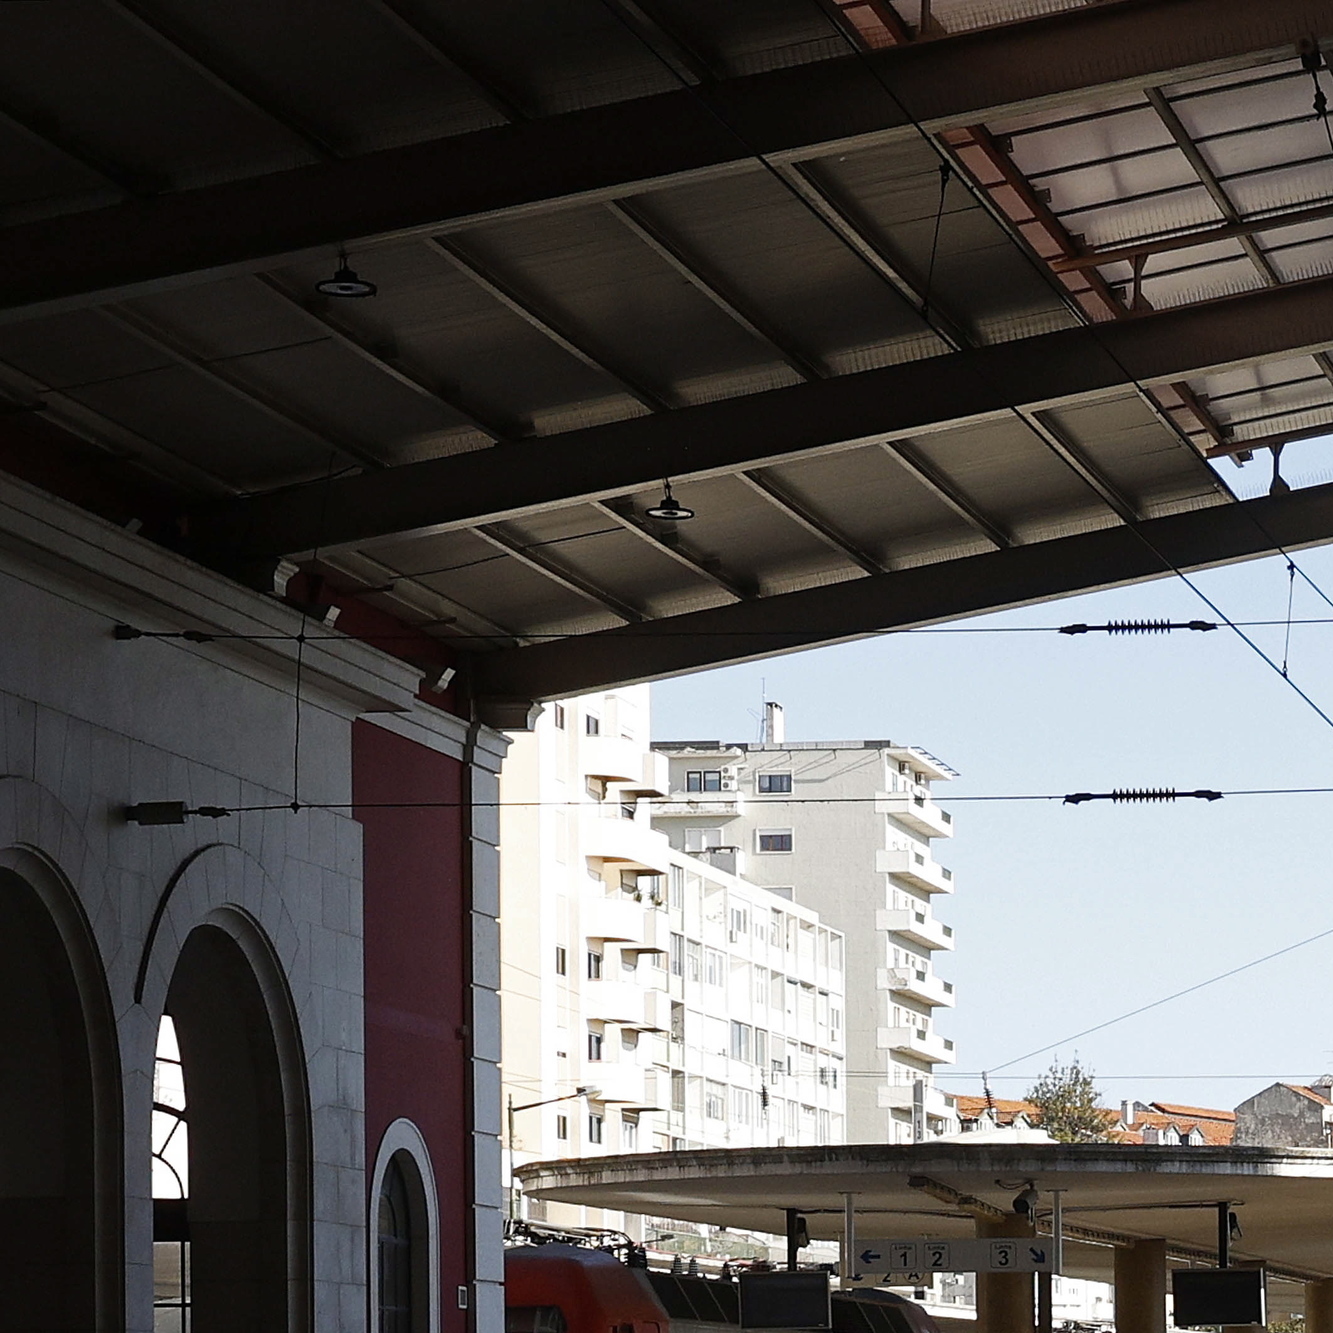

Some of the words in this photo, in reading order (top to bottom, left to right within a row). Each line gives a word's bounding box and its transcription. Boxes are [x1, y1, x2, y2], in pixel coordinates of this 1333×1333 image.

[900, 1252, 908, 1267] 1
[931, 1252, 943, 1267] 2
[998, 1250, 1009, 1266] 3
